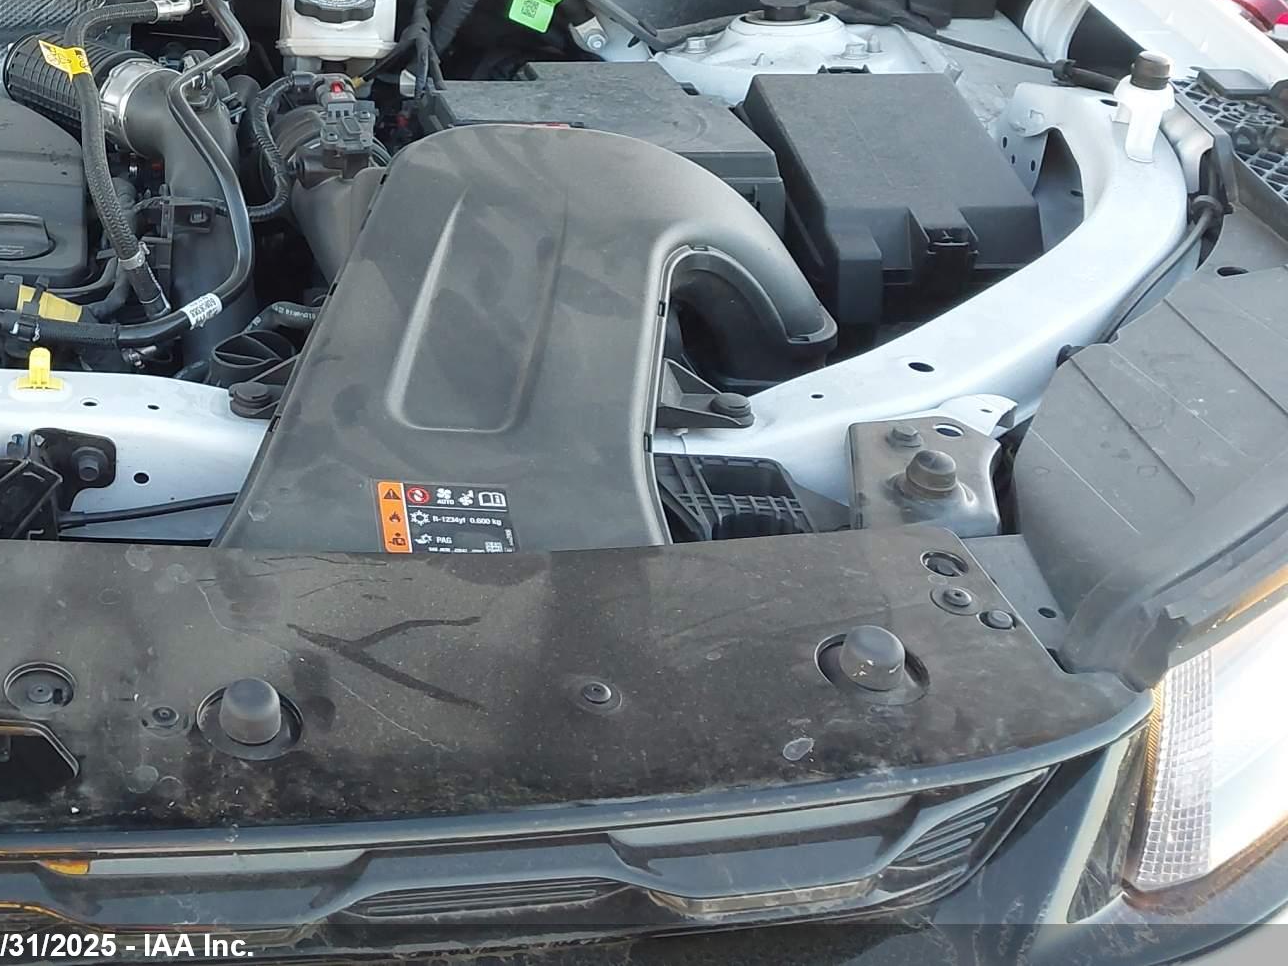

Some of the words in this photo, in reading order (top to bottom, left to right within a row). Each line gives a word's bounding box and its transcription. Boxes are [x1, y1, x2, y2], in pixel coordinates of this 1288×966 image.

[432, 515, 466, 525] R-1234yf
[491, 518, 502, 526] kg
[436, 536, 453, 544] PAG
